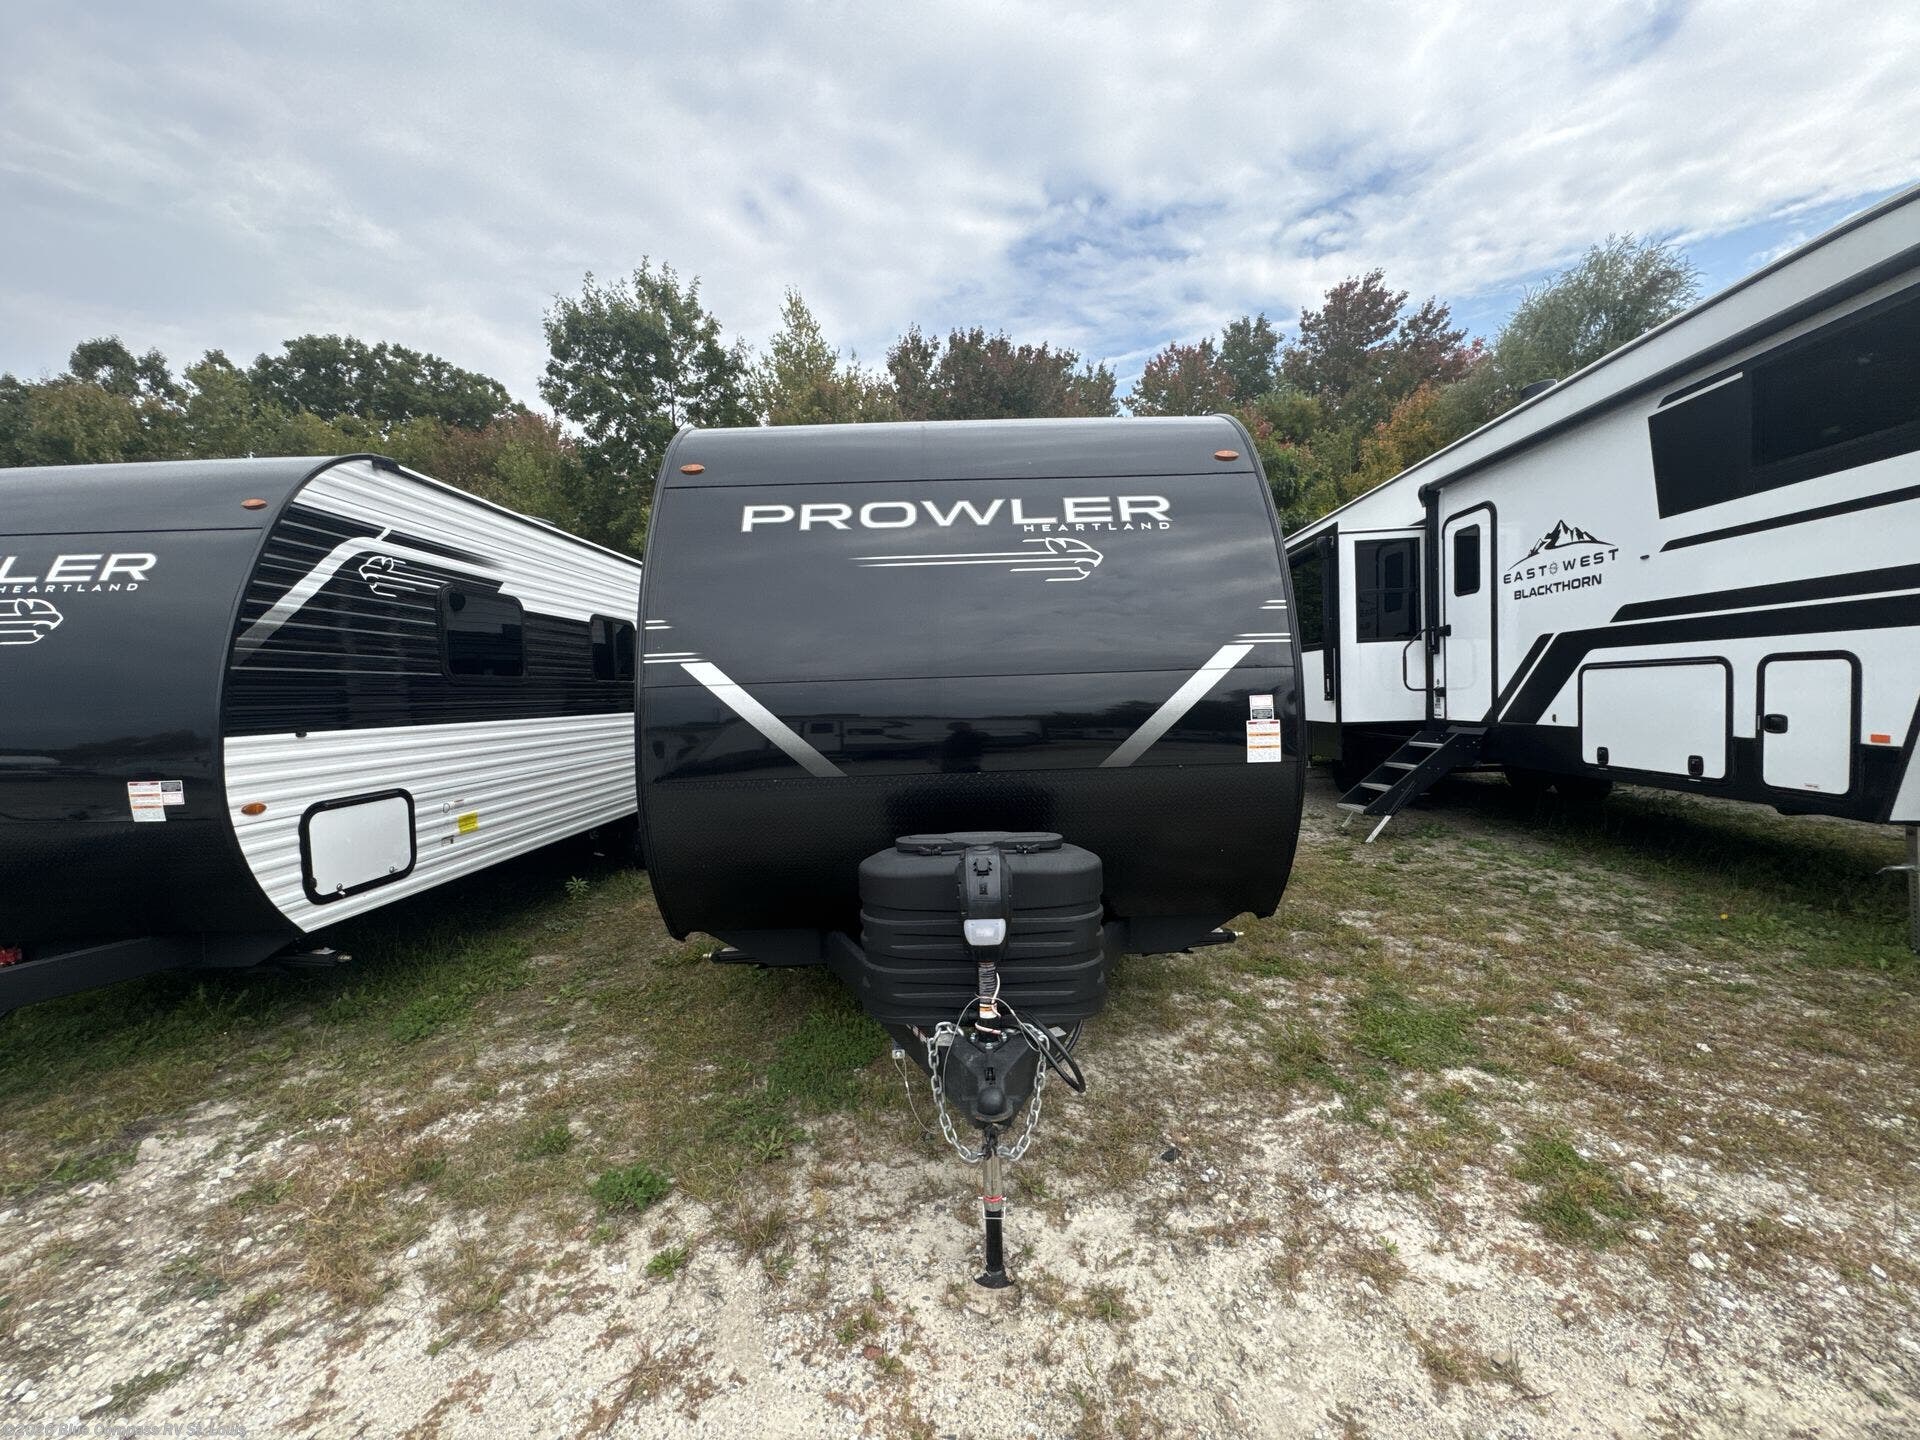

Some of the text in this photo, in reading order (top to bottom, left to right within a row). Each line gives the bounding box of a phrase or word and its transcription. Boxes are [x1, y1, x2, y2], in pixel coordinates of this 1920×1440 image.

[741, 495, 1173, 532] PROWLER
[1023, 522, 1171, 532] HEARTLAND
[1503, 548, 1619, 584] EAST WEST
[1514, 573, 1602, 600] BLACKTHORN
